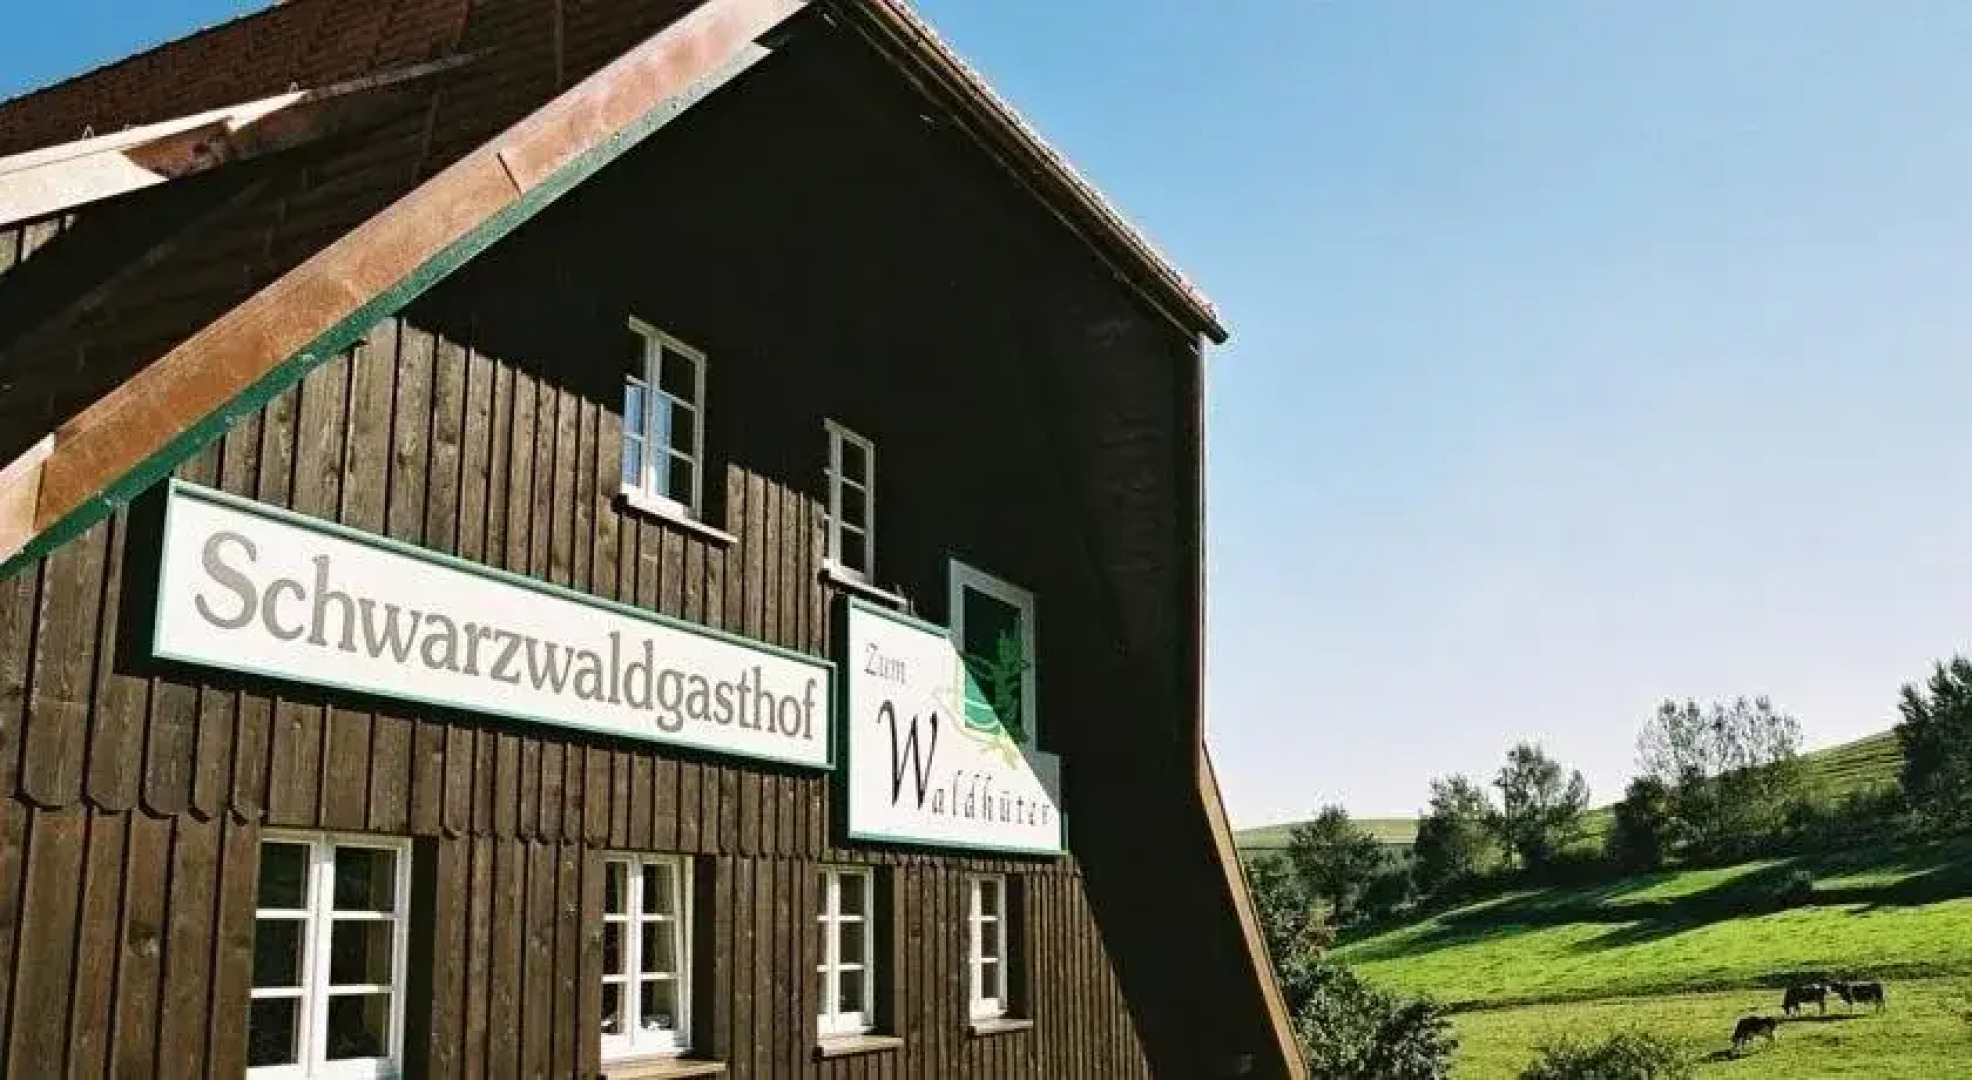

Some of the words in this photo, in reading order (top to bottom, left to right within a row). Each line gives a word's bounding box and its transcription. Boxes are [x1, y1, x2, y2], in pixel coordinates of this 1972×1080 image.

[194, 530, 816, 740] Schwarzwaldgasthof
[864, 642, 907, 685] Zum
[876, 699, 1051, 827] Waldhüter
